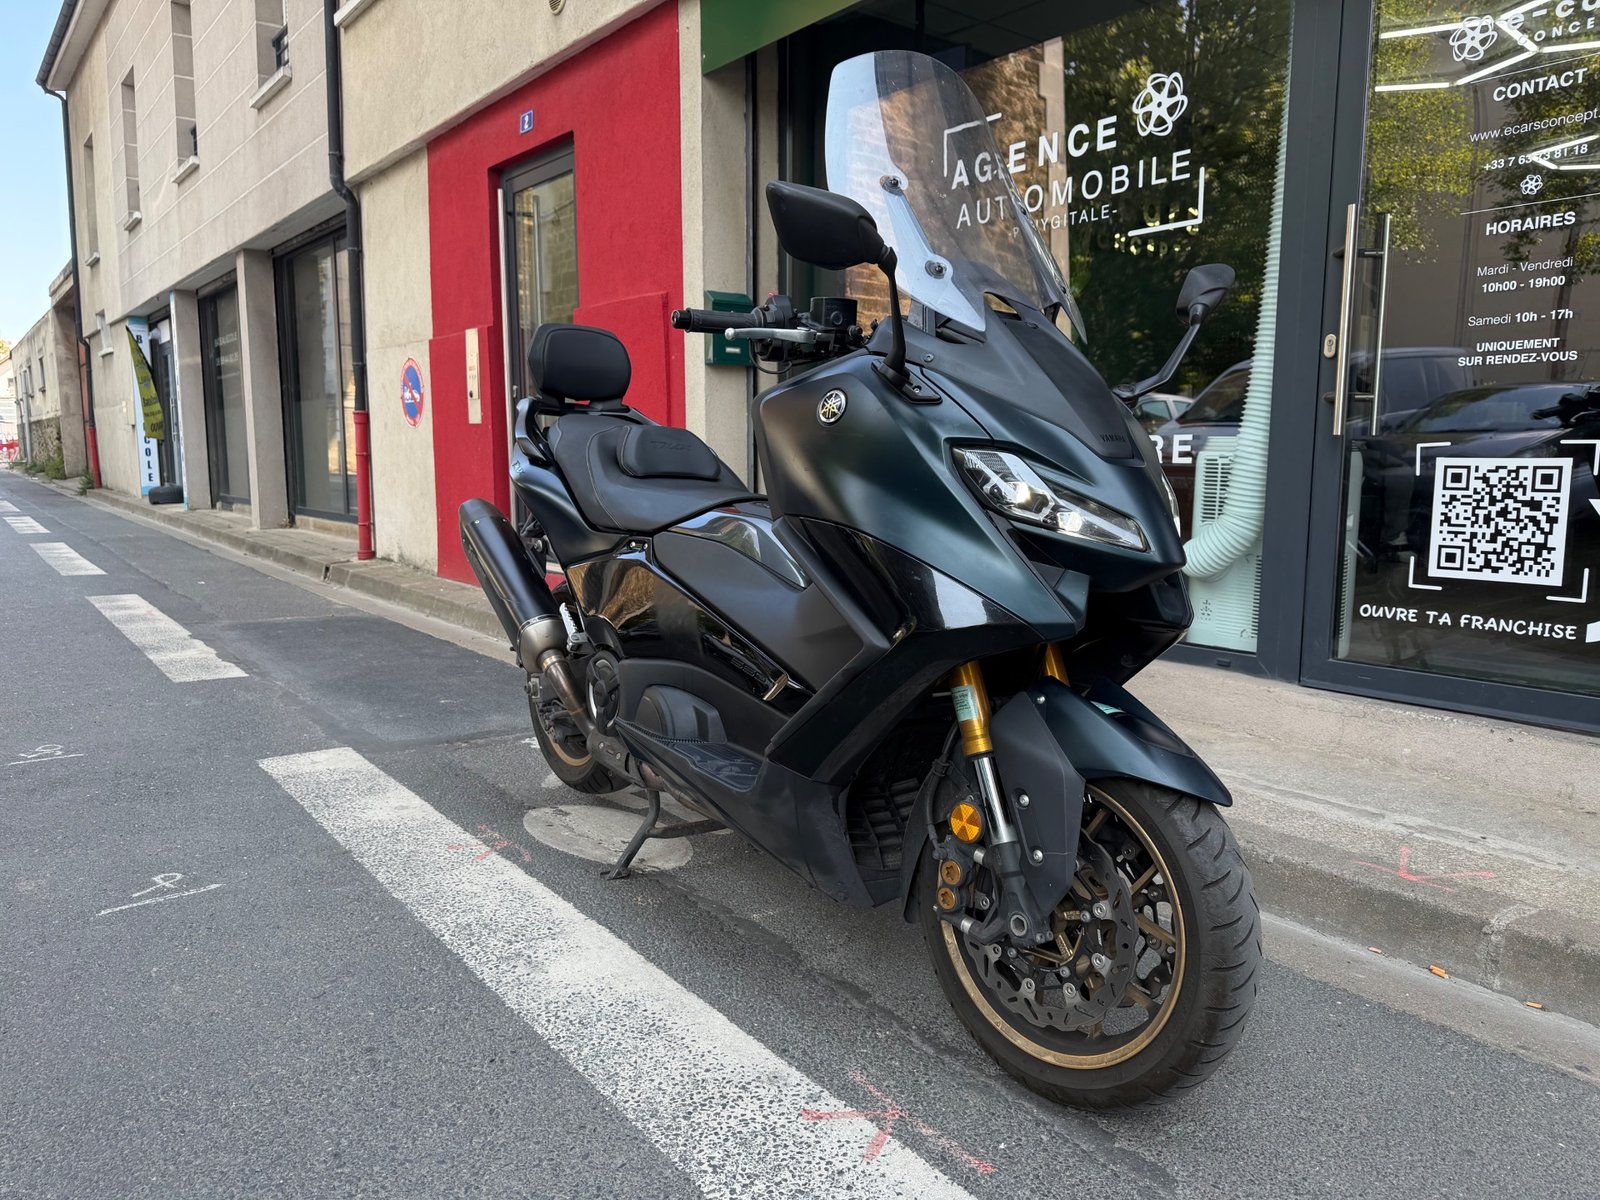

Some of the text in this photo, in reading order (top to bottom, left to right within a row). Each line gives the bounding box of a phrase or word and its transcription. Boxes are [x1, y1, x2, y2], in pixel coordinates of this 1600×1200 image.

[1493, 67, 1588, 101] CONTACT
[951, 115, 1117, 190] AGENCE
[1483, 159, 1505, 171] +33
[1508, 157, 1516, 167] 7
[1518, 155, 1532, 165] 63
[1554, 149, 1568, 159] 81
[1573, 144, 1588, 155] 18
[956, 149, 1191, 229] AUTOMOBILE
[1485, 211, 1576, 236] HORAIRES
[1477, 264, 1509, 277] Mardi
[1520, 257, 1574, 273] Vendredi
[1482, 280, 1517, 293] 10h00
[1528, 275, 1566, 288] 19h00
[1468, 313, 1511, 327] Samedi
[1515, 311, 1537, 323] 10h
[1550, 309, 1573, 320] 17h
[1476, 338, 1560, 352] UNIQUEMENT
[1457, 351, 1578, 367] SUR RENDEZ-VOUS
[1359, 603, 1577, 640] OUVRE TA FRANCHISE
